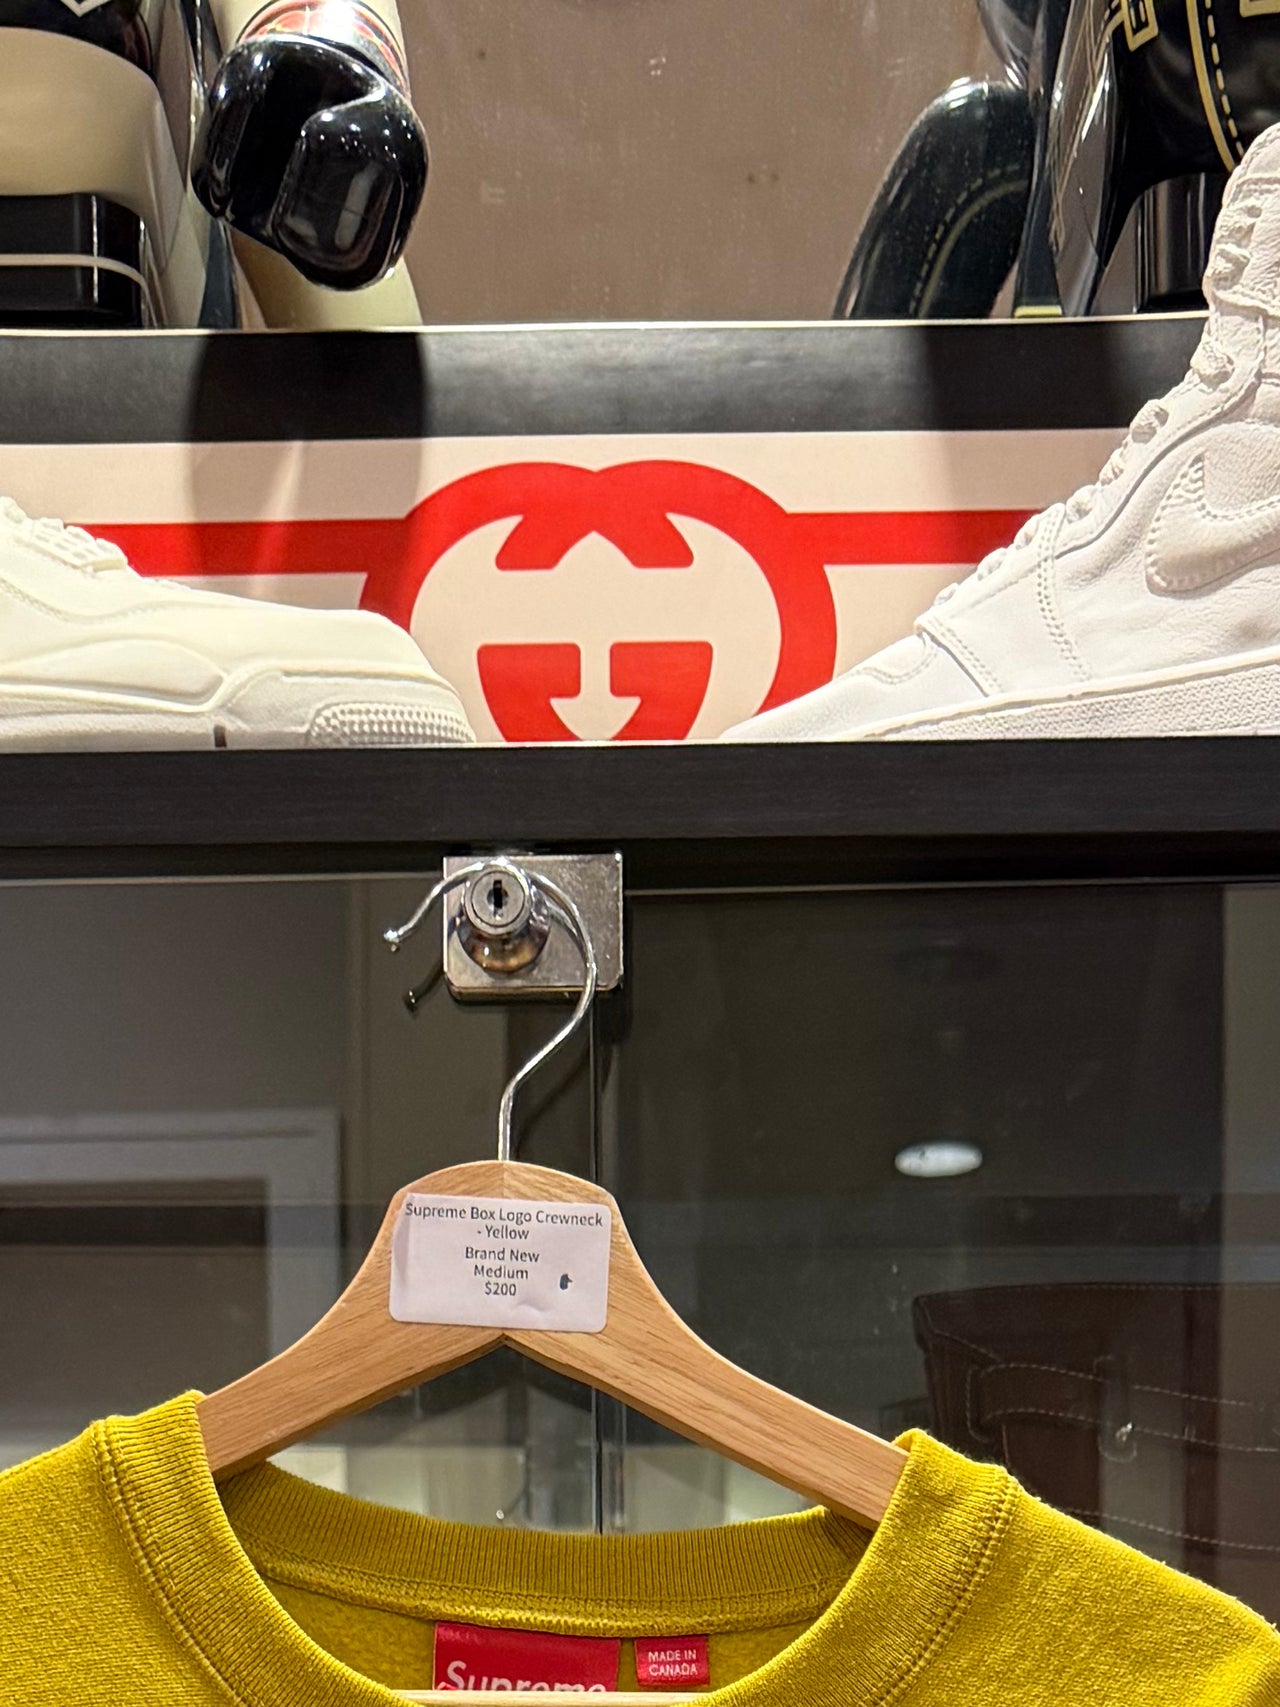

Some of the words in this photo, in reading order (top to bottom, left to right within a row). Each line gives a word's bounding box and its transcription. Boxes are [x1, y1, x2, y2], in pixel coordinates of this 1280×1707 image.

[405, 1203, 467, 1219] Supreme
[470, 1206, 496, 1220] Box
[499, 1209, 532, 1225] Logo
[535, 1211, 603, 1227] Crewneck
[485, 1225, 530, 1240] Yellow
[465, 1246, 505, 1261] Brand
[509, 1250, 540, 1263] New
[473, 1265, 529, 1280] Medium
[484, 1281, 517, 1297] $200
[648, 1650, 681, 1662] MADE
[684, 1649, 697, 1660] IN
[648, 1662, 698, 1677] CANADA
